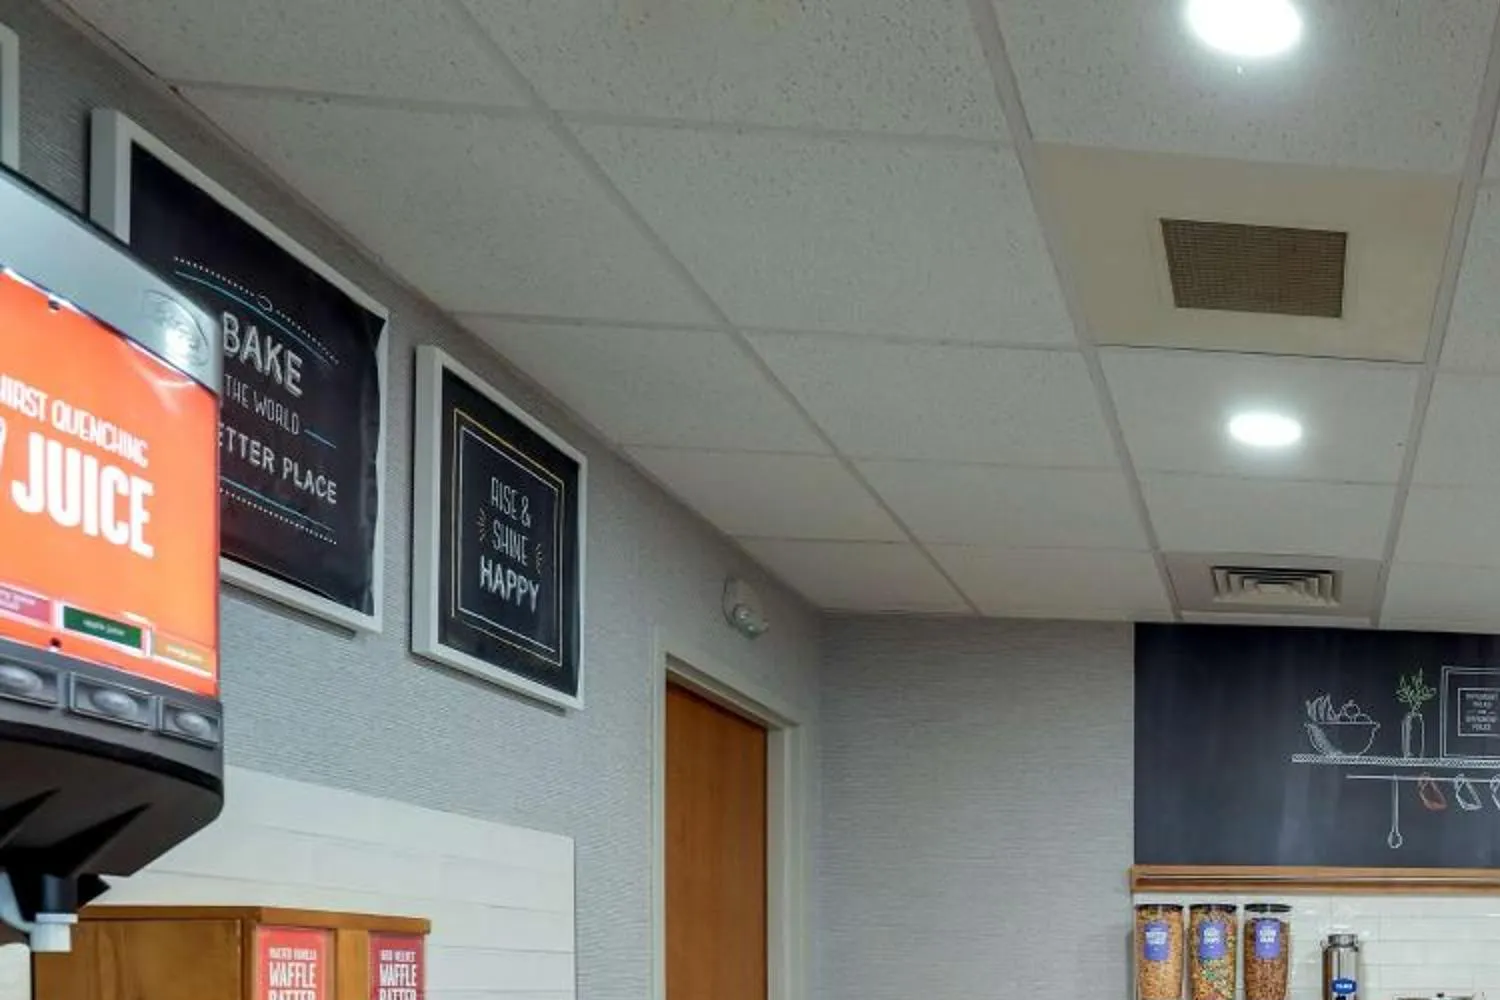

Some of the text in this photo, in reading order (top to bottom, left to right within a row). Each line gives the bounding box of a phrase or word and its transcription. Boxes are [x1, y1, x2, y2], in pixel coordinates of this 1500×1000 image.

[223, 311, 304, 398] BAKE
[224, 373, 300, 436] THE WORLD
[11, 431, 155, 559] JUICE
[282, 457, 338, 505] PLACE
[490, 476, 531, 528] RISE &
[492, 519, 529, 567] SHINE
[479, 555, 540, 614] HAPPY
[269, 961, 318, 989] WAFFLE
[379, 963, 417, 987] WAFFLE
